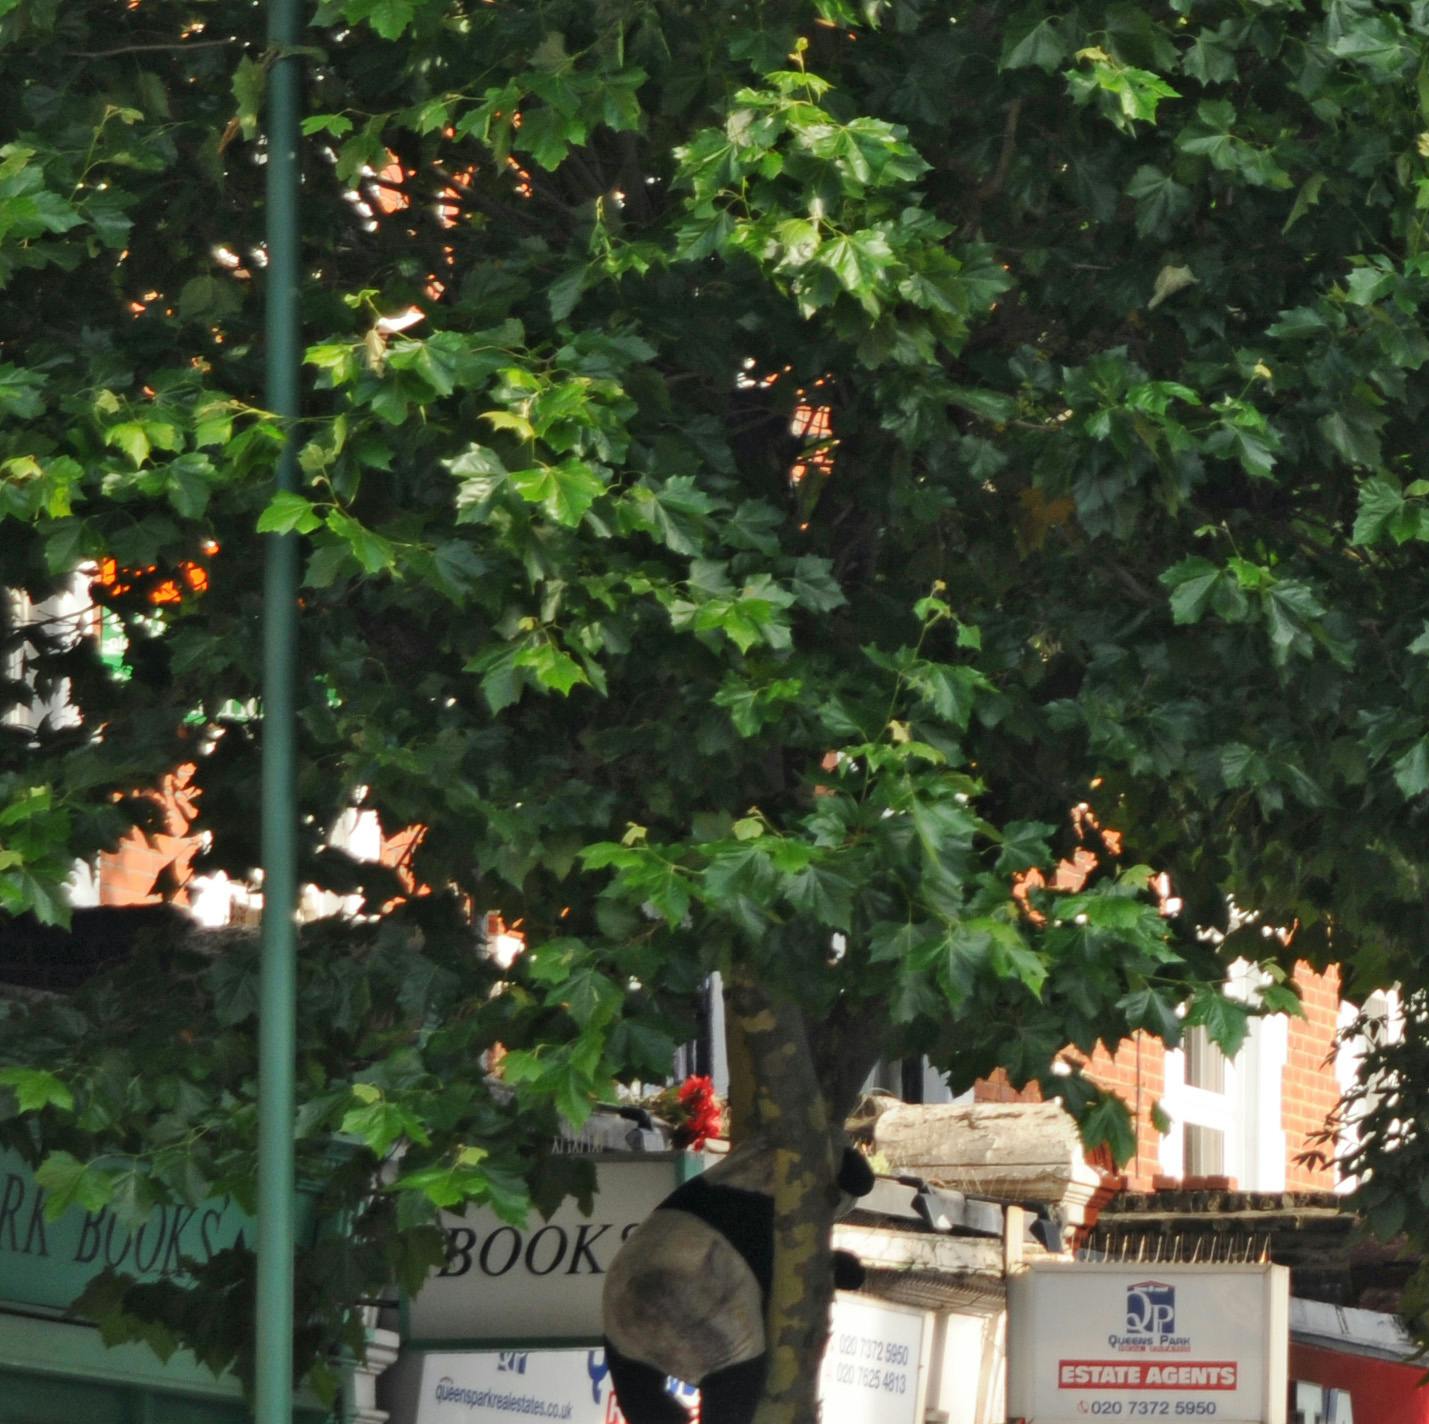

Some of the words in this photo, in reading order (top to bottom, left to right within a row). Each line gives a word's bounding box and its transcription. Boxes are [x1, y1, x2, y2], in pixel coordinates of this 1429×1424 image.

[436, 1223, 640, 1277] BOOK
[1061, 1366, 1141, 1385] ESTATE
[1146, 1367, 1236, 1386] AGENTS
[1091, 1401, 1122, 1415] 020
[1129, 1401, 1169, 1415] 7372
[1175, 1402, 1217, 1416] 5950
